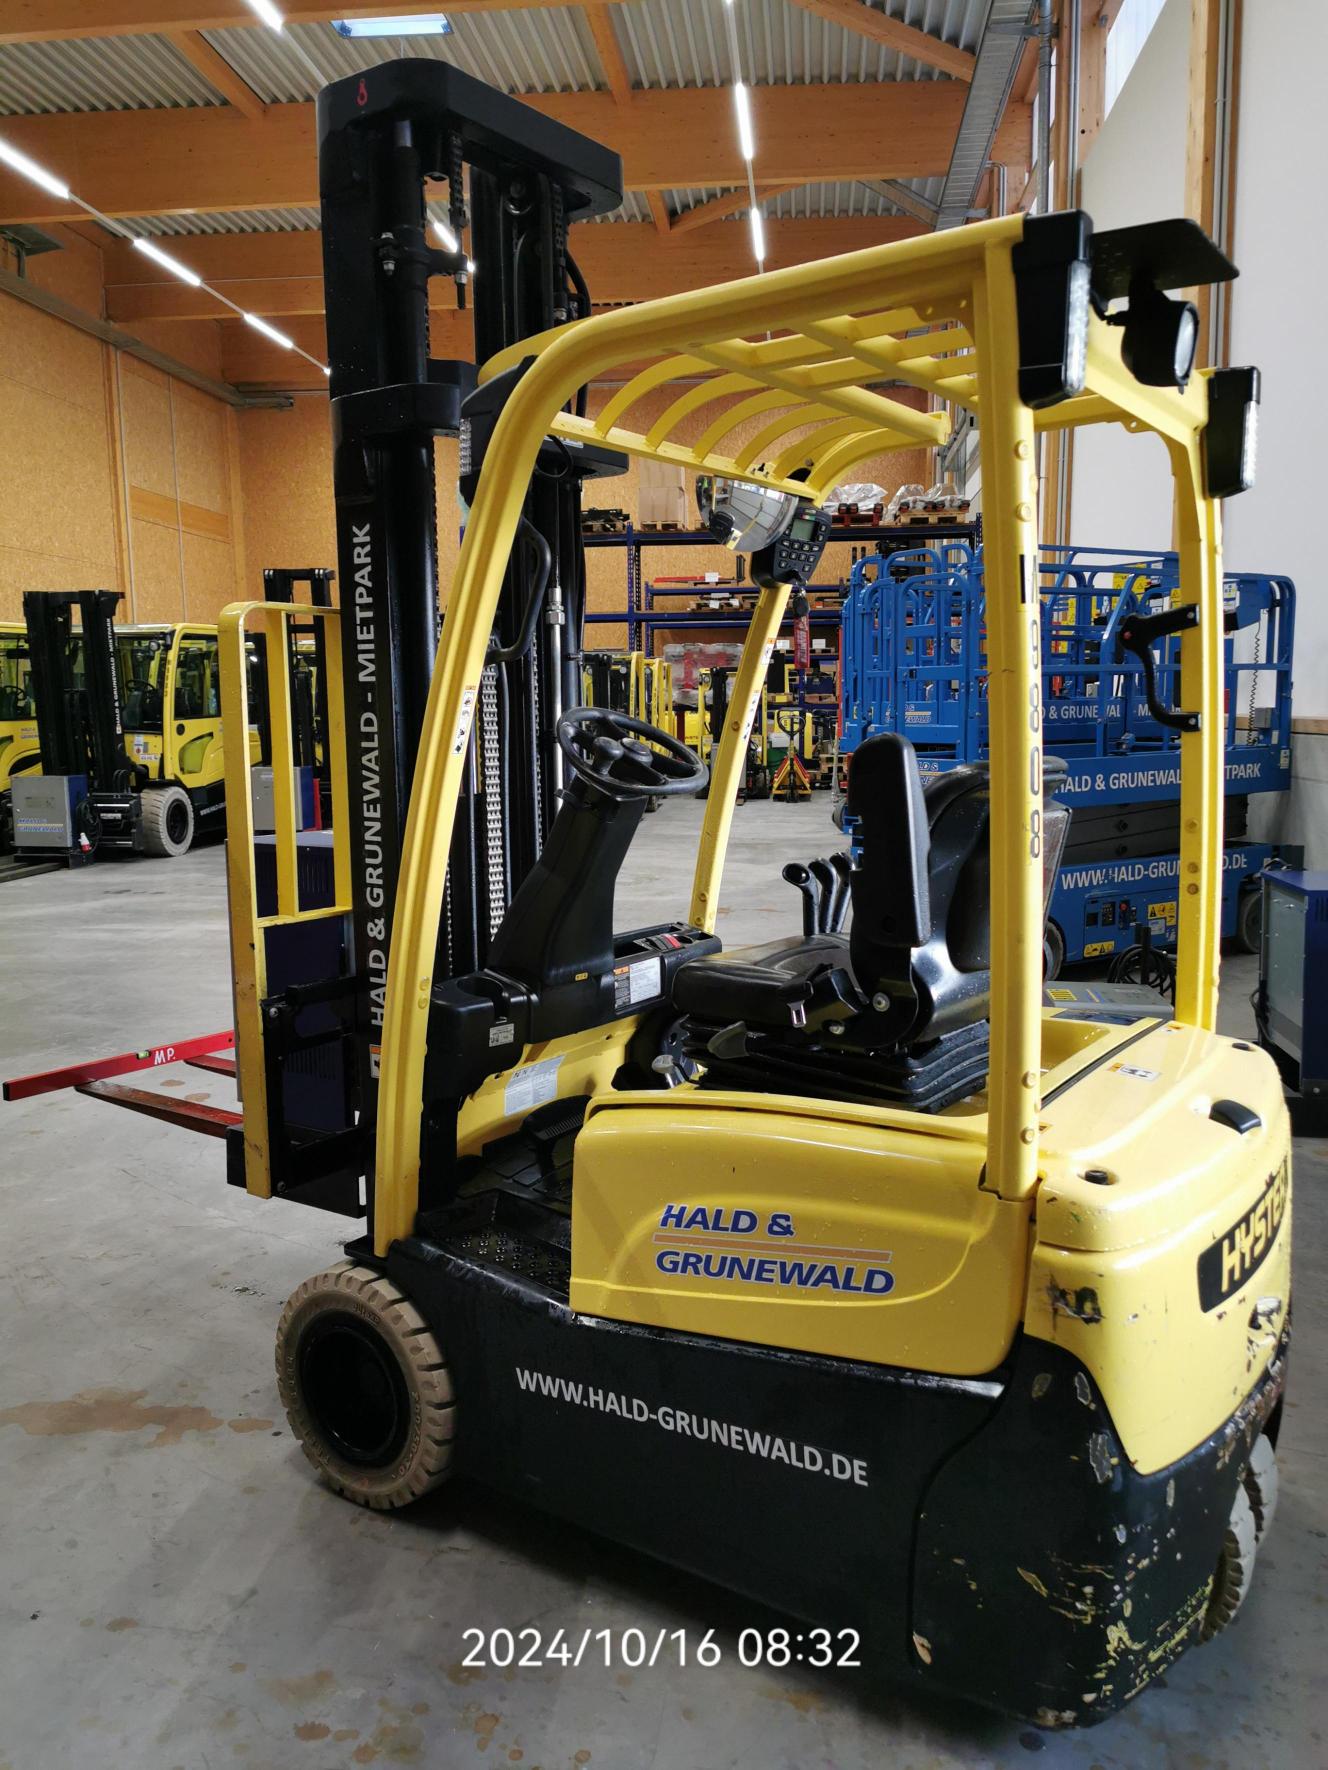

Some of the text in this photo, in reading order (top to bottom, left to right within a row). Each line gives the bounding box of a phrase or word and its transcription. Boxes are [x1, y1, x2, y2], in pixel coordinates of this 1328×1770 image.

[352, 523, 387, 1026] HALD & GRUNEWALD - MIETPARK
[1095, 774, 1106, 790] &
[1109, 769, 1182, 789] GRUNEWAL
[659, 1203, 796, 1236] HALD &
[656, 1250, 895, 1294] GRUNEWALD
[515, 1367, 869, 1487] WWW.HALD-GRUNEWALD.DE
